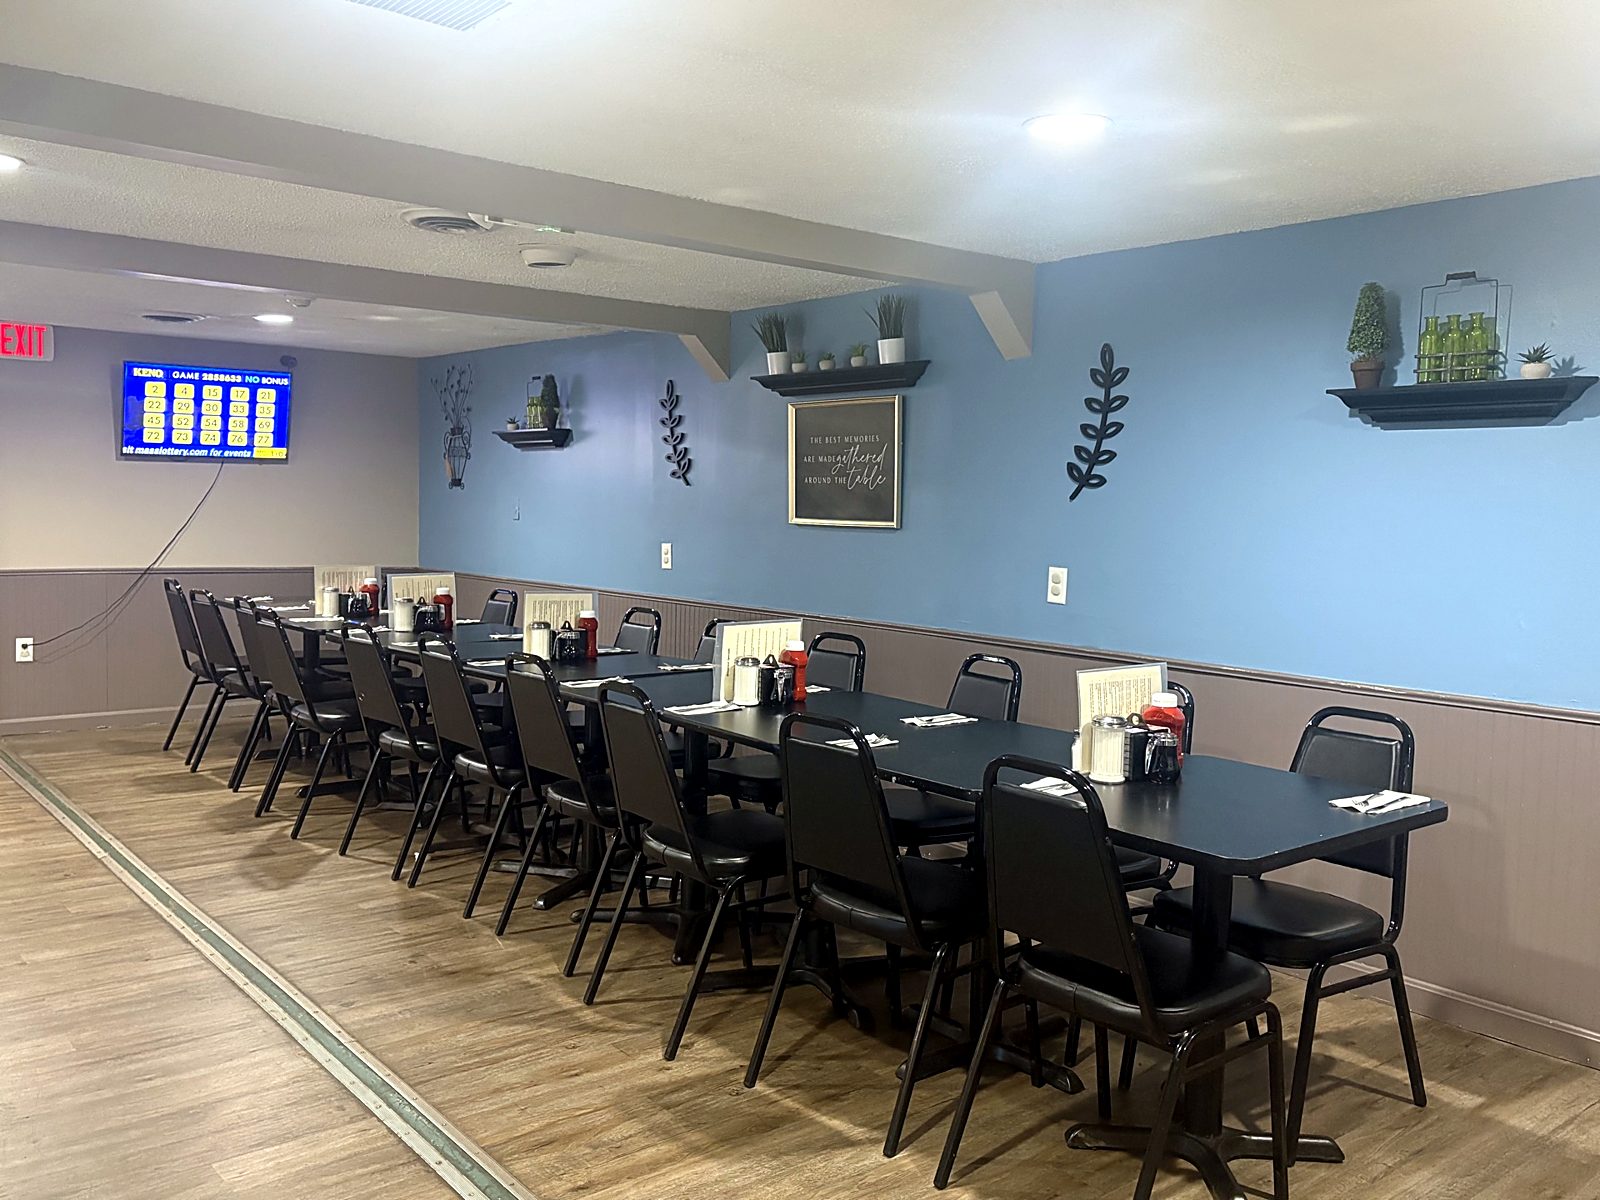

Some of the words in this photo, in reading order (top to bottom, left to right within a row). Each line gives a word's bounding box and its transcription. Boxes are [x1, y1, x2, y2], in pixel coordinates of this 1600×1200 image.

[0, 322, 47, 359] EXIT
[133, 367, 164, 378] KENO
[172, 371, 199, 379] GAME
[245, 375, 260, 383] NO
[261, 377, 289, 385] BONUS
[152, 385, 158, 393] 2
[181, 387, 187, 395] 4
[207, 388, 218, 396] 15
[235, 390, 245, 398] 17
[260, 391, 270, 399] 21
[148, 401, 161, 409] 22
[177, 402, 190, 410] 29
[205, 403, 218, 411] 30
[232, 405, 244, 413] 33
[259, 406, 271, 414] 35
[147, 416, 160, 424] 45
[231, 420, 243, 428] 58
[147, 431, 160, 439] 72
[810, 436, 822, 444] THE
[825, 436, 840, 444] BEST
[844, 434, 880, 443] MEMORIES
[210, 448, 222, 456] for
[803, 455, 815, 463] ARE
[818, 455, 835, 463] MADE
[831, 443, 888, 475] gathered
[805, 476, 831, 484] AROUND
[835, 476, 846, 484] THE
[846, 464, 886, 490] table
